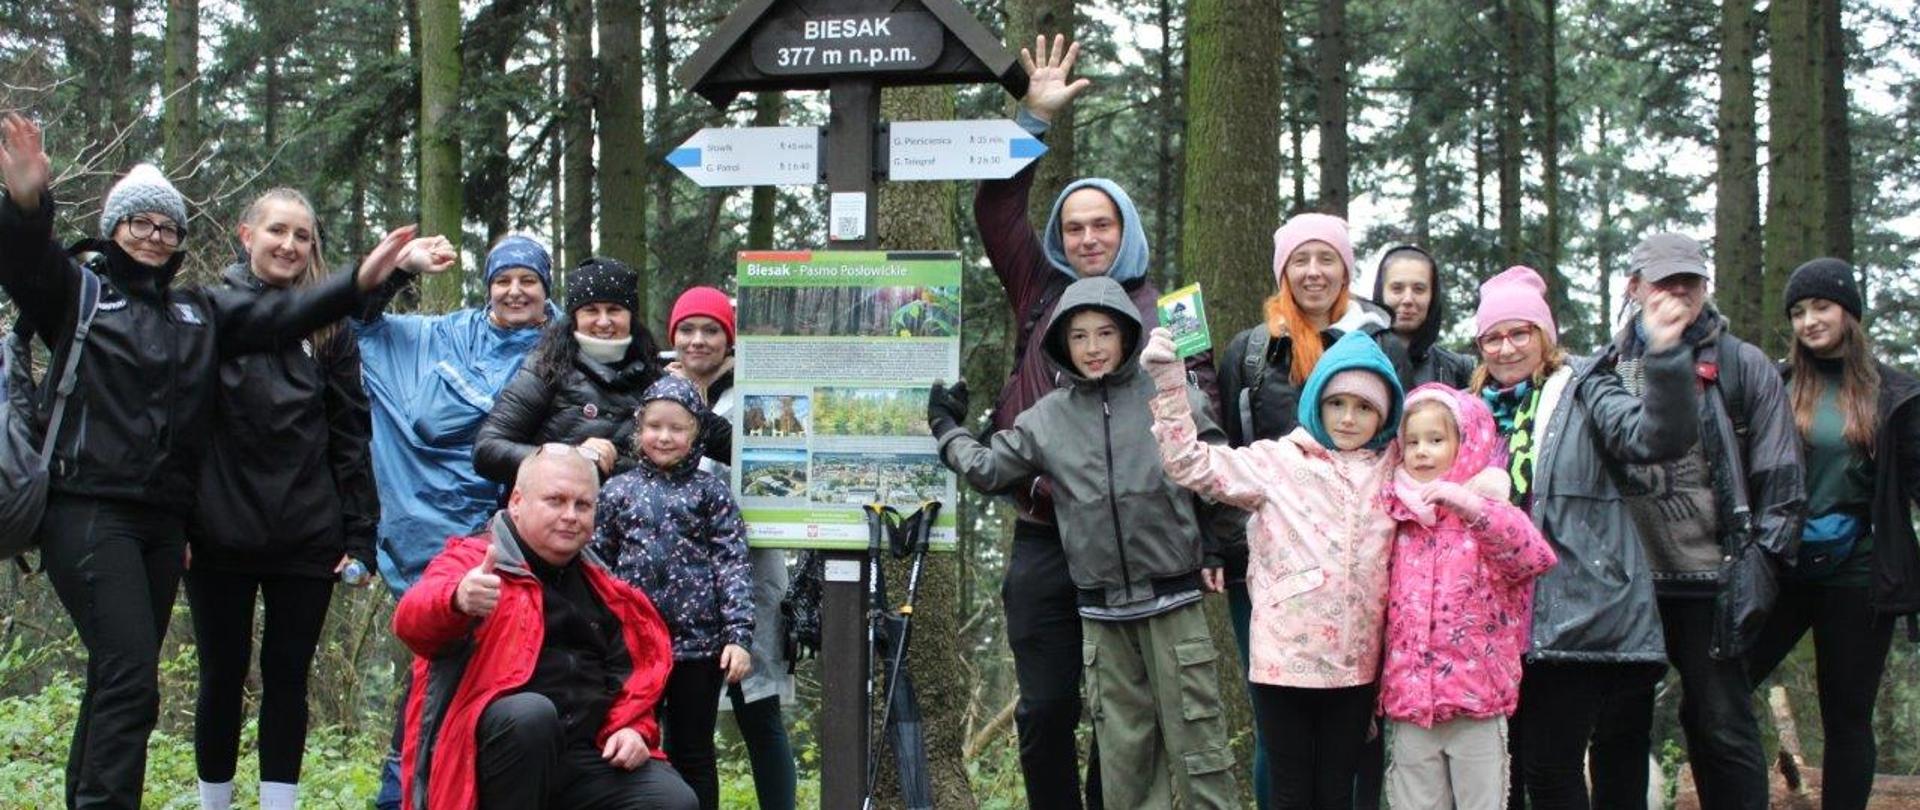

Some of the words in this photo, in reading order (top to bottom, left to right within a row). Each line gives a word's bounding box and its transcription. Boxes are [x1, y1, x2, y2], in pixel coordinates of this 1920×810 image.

[803, 17, 891, 40] BIESAK
[777, 46, 816, 67] 377
[822, 48, 842, 65] m
[848, 46, 917, 67] n.p.m.
[747, 263, 790, 277] Biesak
[800, 264, 838, 277] Pasmo
[841, 263, 908, 278] Posłowickie
